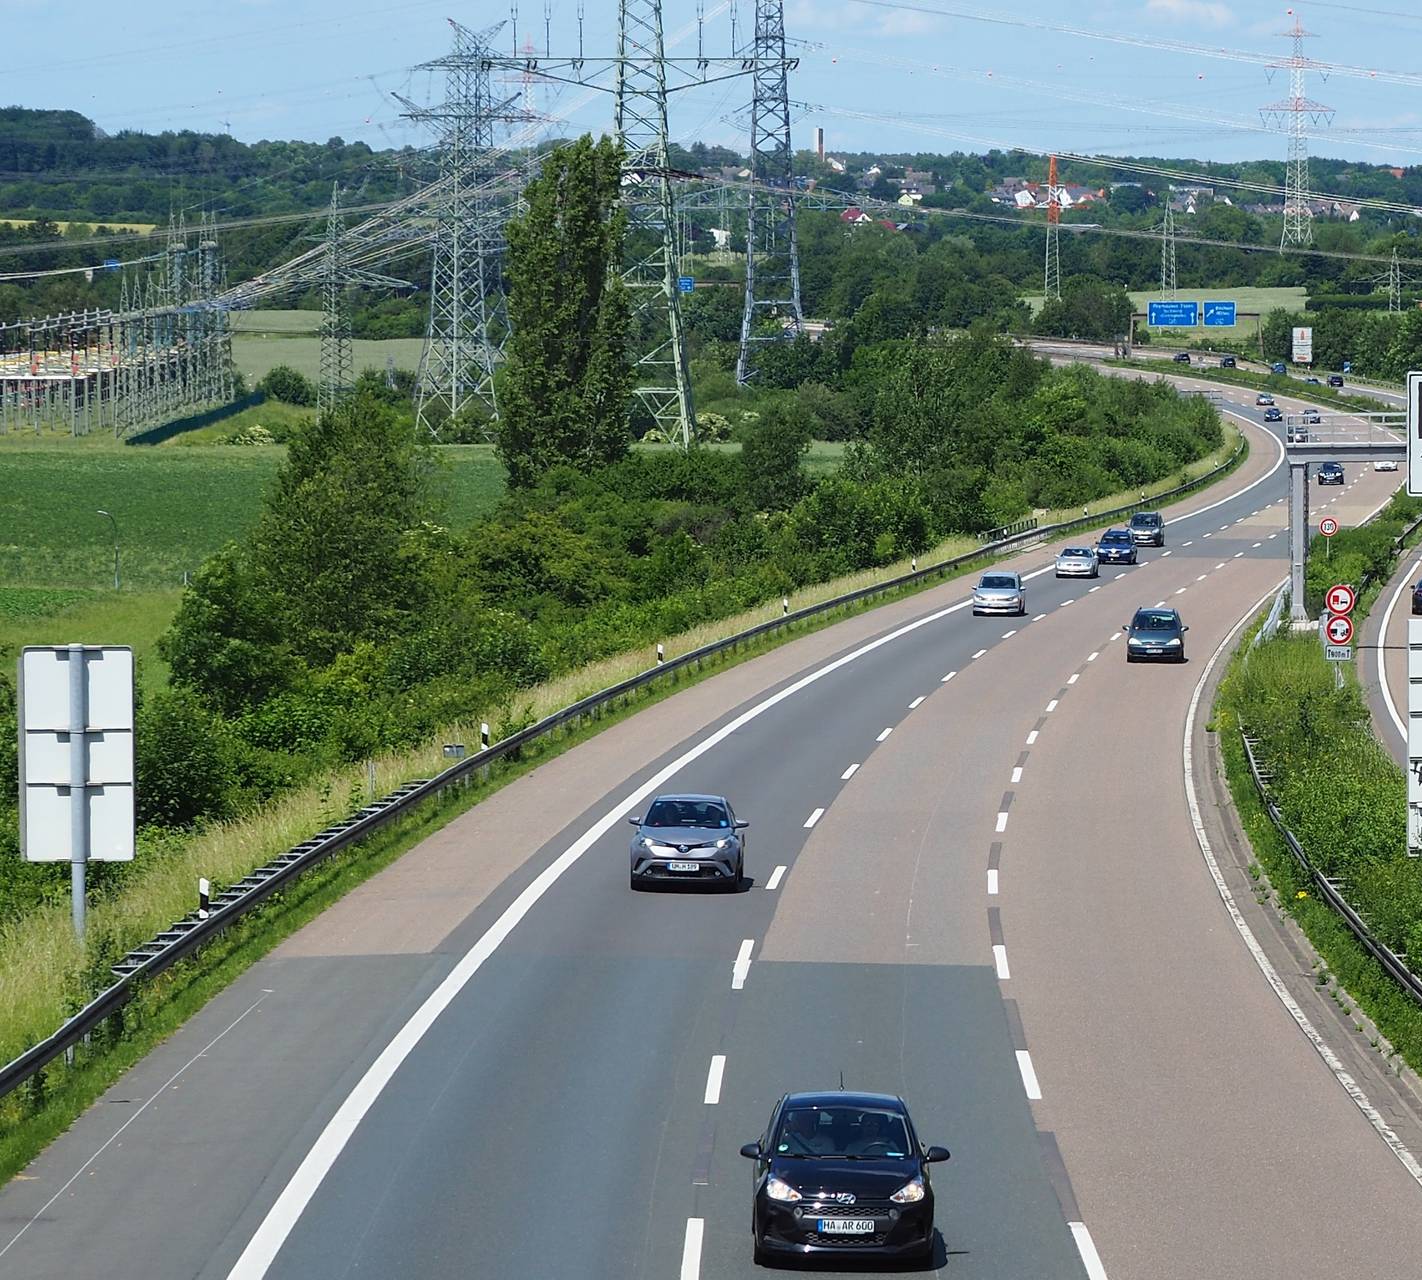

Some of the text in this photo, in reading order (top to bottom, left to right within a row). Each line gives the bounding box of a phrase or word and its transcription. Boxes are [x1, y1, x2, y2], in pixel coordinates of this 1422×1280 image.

[1324, 523, 1334, 531] 130
[823, 1221, 873, 1231] HA AR 600
